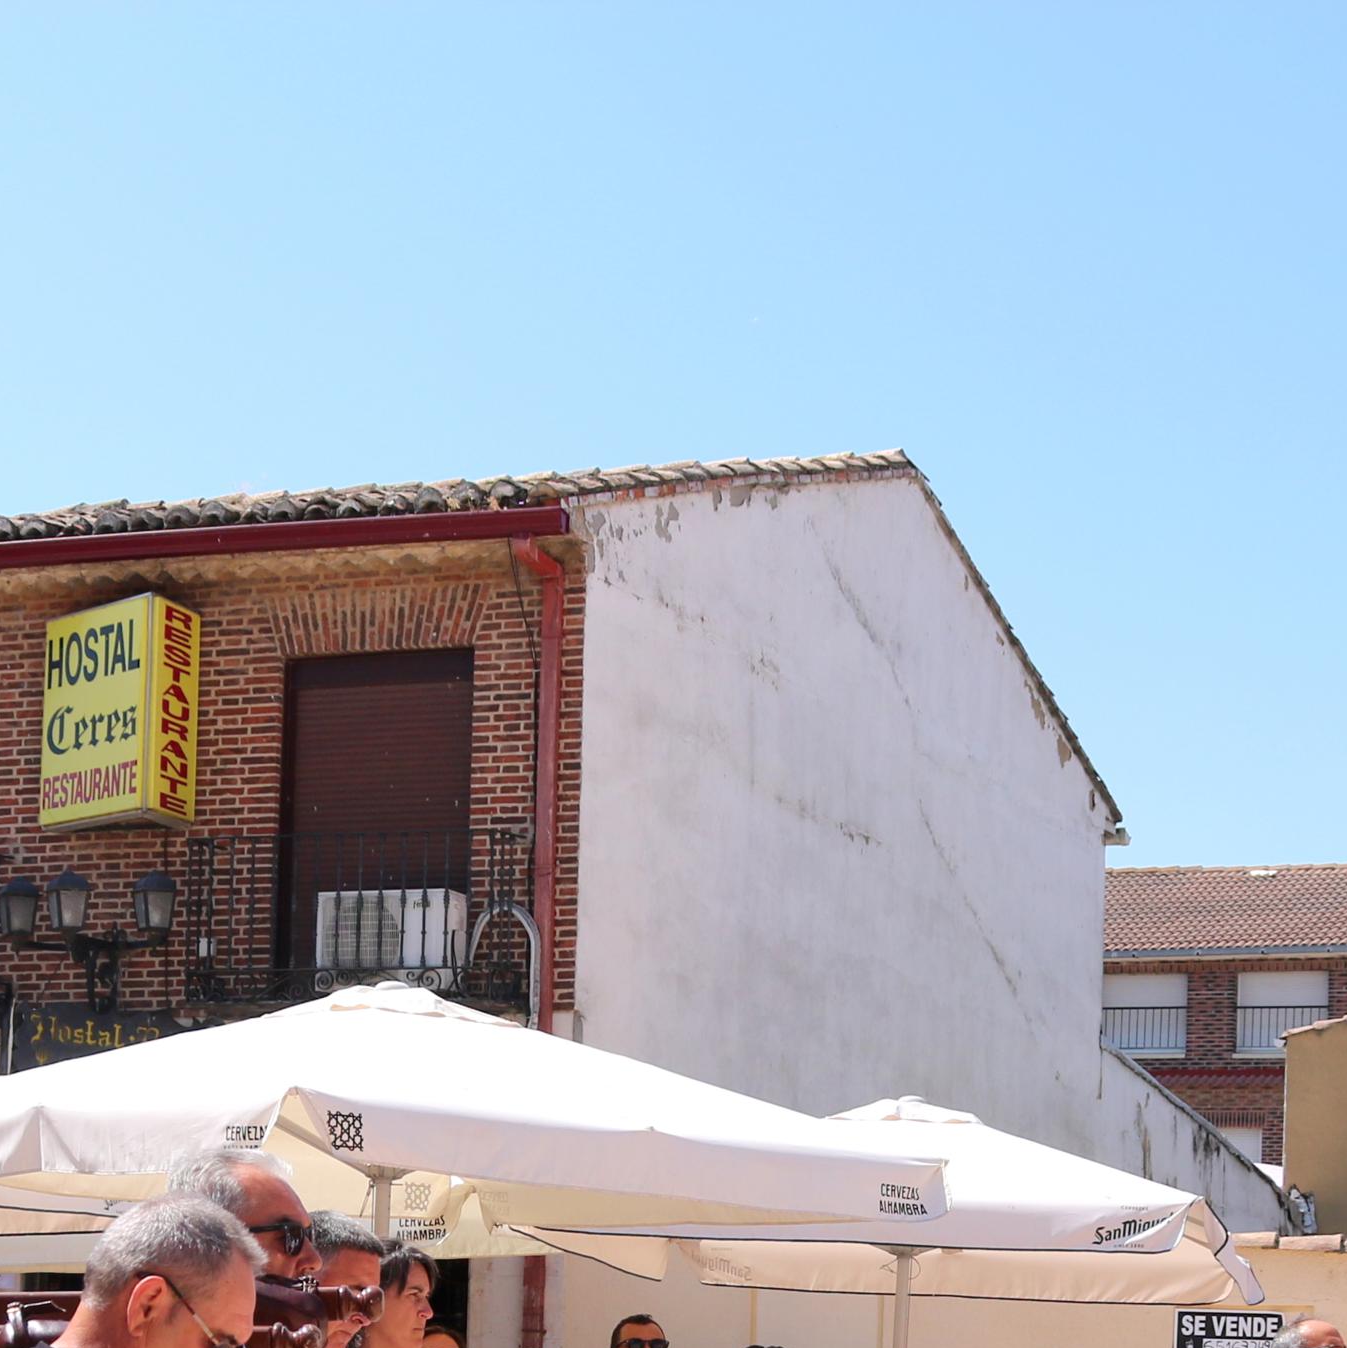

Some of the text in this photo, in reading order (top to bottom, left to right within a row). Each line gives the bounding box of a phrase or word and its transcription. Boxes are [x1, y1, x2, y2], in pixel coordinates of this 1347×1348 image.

[47, 619, 140, 690] HOSTAL
[159, 605, 192, 816] RESTAURANTE
[46, 704, 138, 755] Ceres
[42, 759, 138, 810] RESTAURANTE
[225, 1125, 268, 1142] CERVEZA
[879, 1199, 928, 1216] ALHAMBRA
[880, 1183, 920, 1201] CERVEZAS
[1181, 1314, 1279, 1338] SE VENDE
